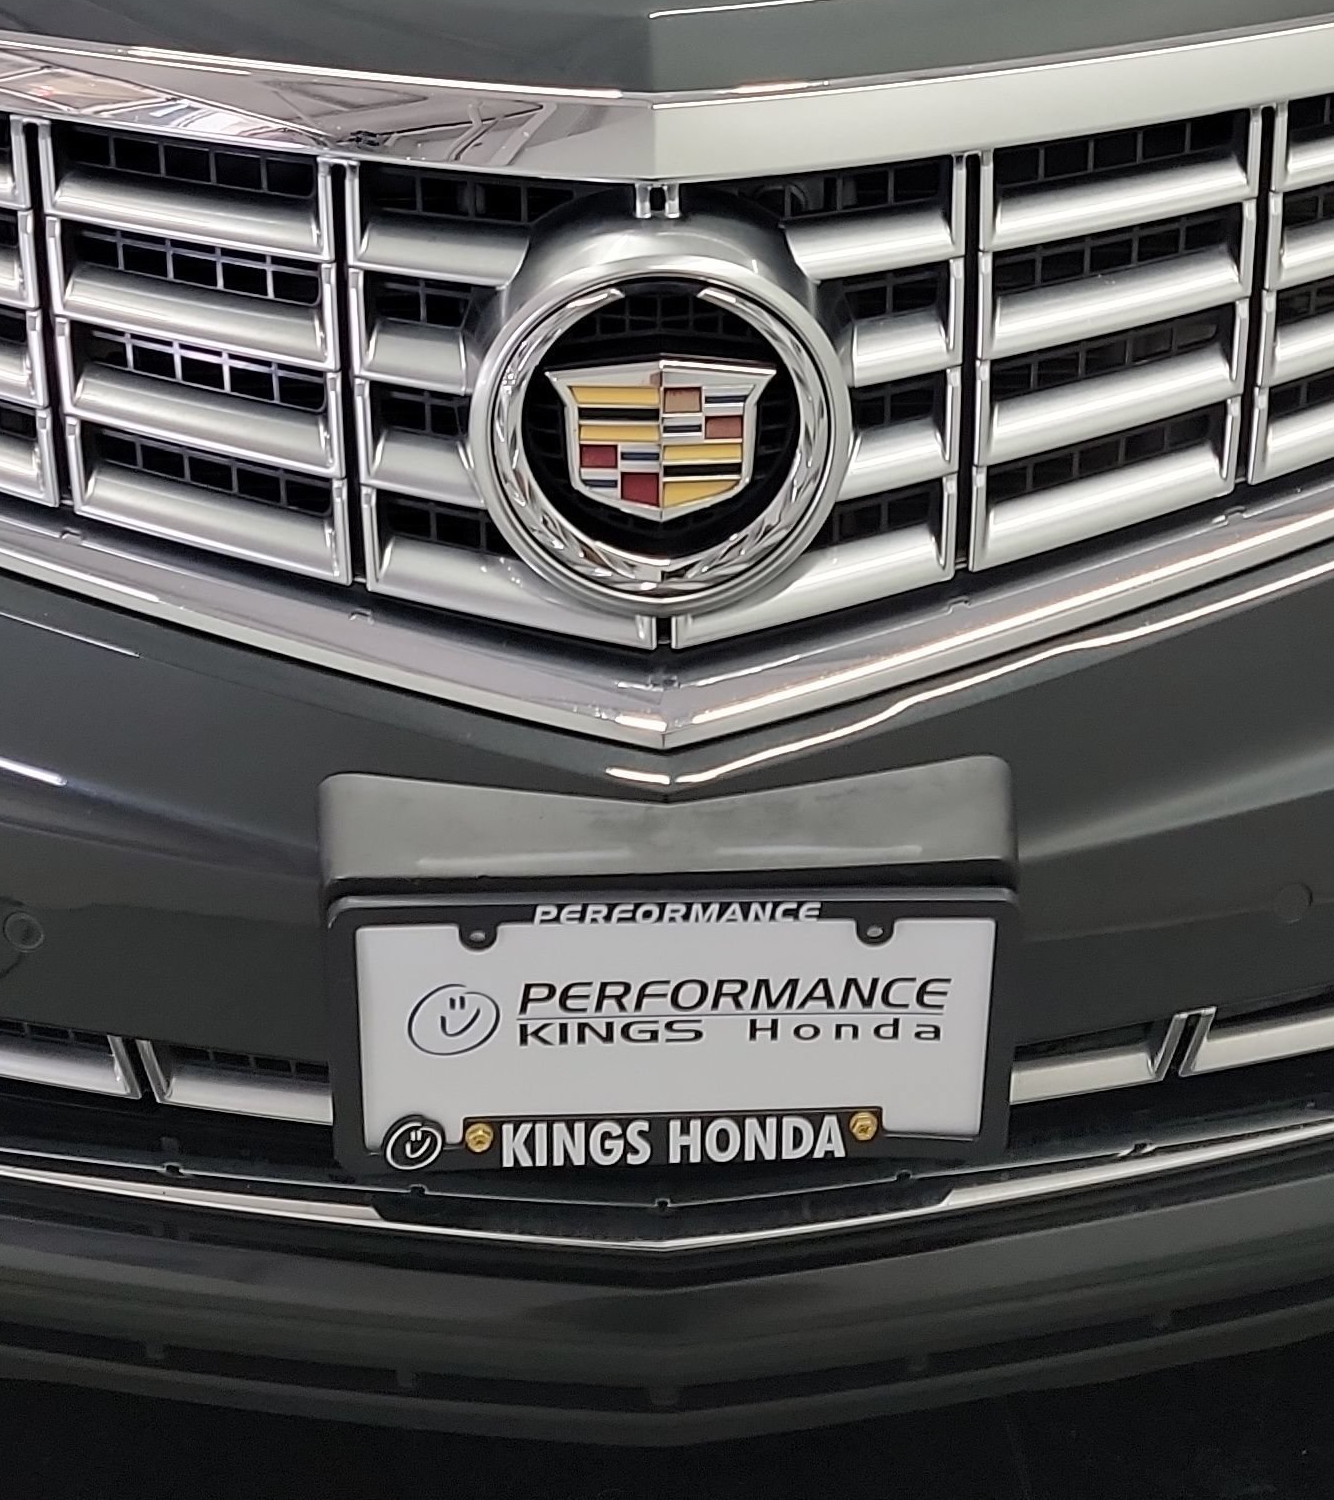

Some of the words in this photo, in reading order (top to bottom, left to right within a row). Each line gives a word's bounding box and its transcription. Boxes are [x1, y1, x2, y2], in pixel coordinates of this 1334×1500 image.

[533, 902, 822, 925] PERFORMANCE
[519, 977, 952, 1014] PERFORMANCE
[519, 1020, 704, 1046] KINGS
[749, 1018, 942, 1041] Honda
[501, 1119, 651, 1168] KINGS
[668, 1115, 846, 1164] HONDA
